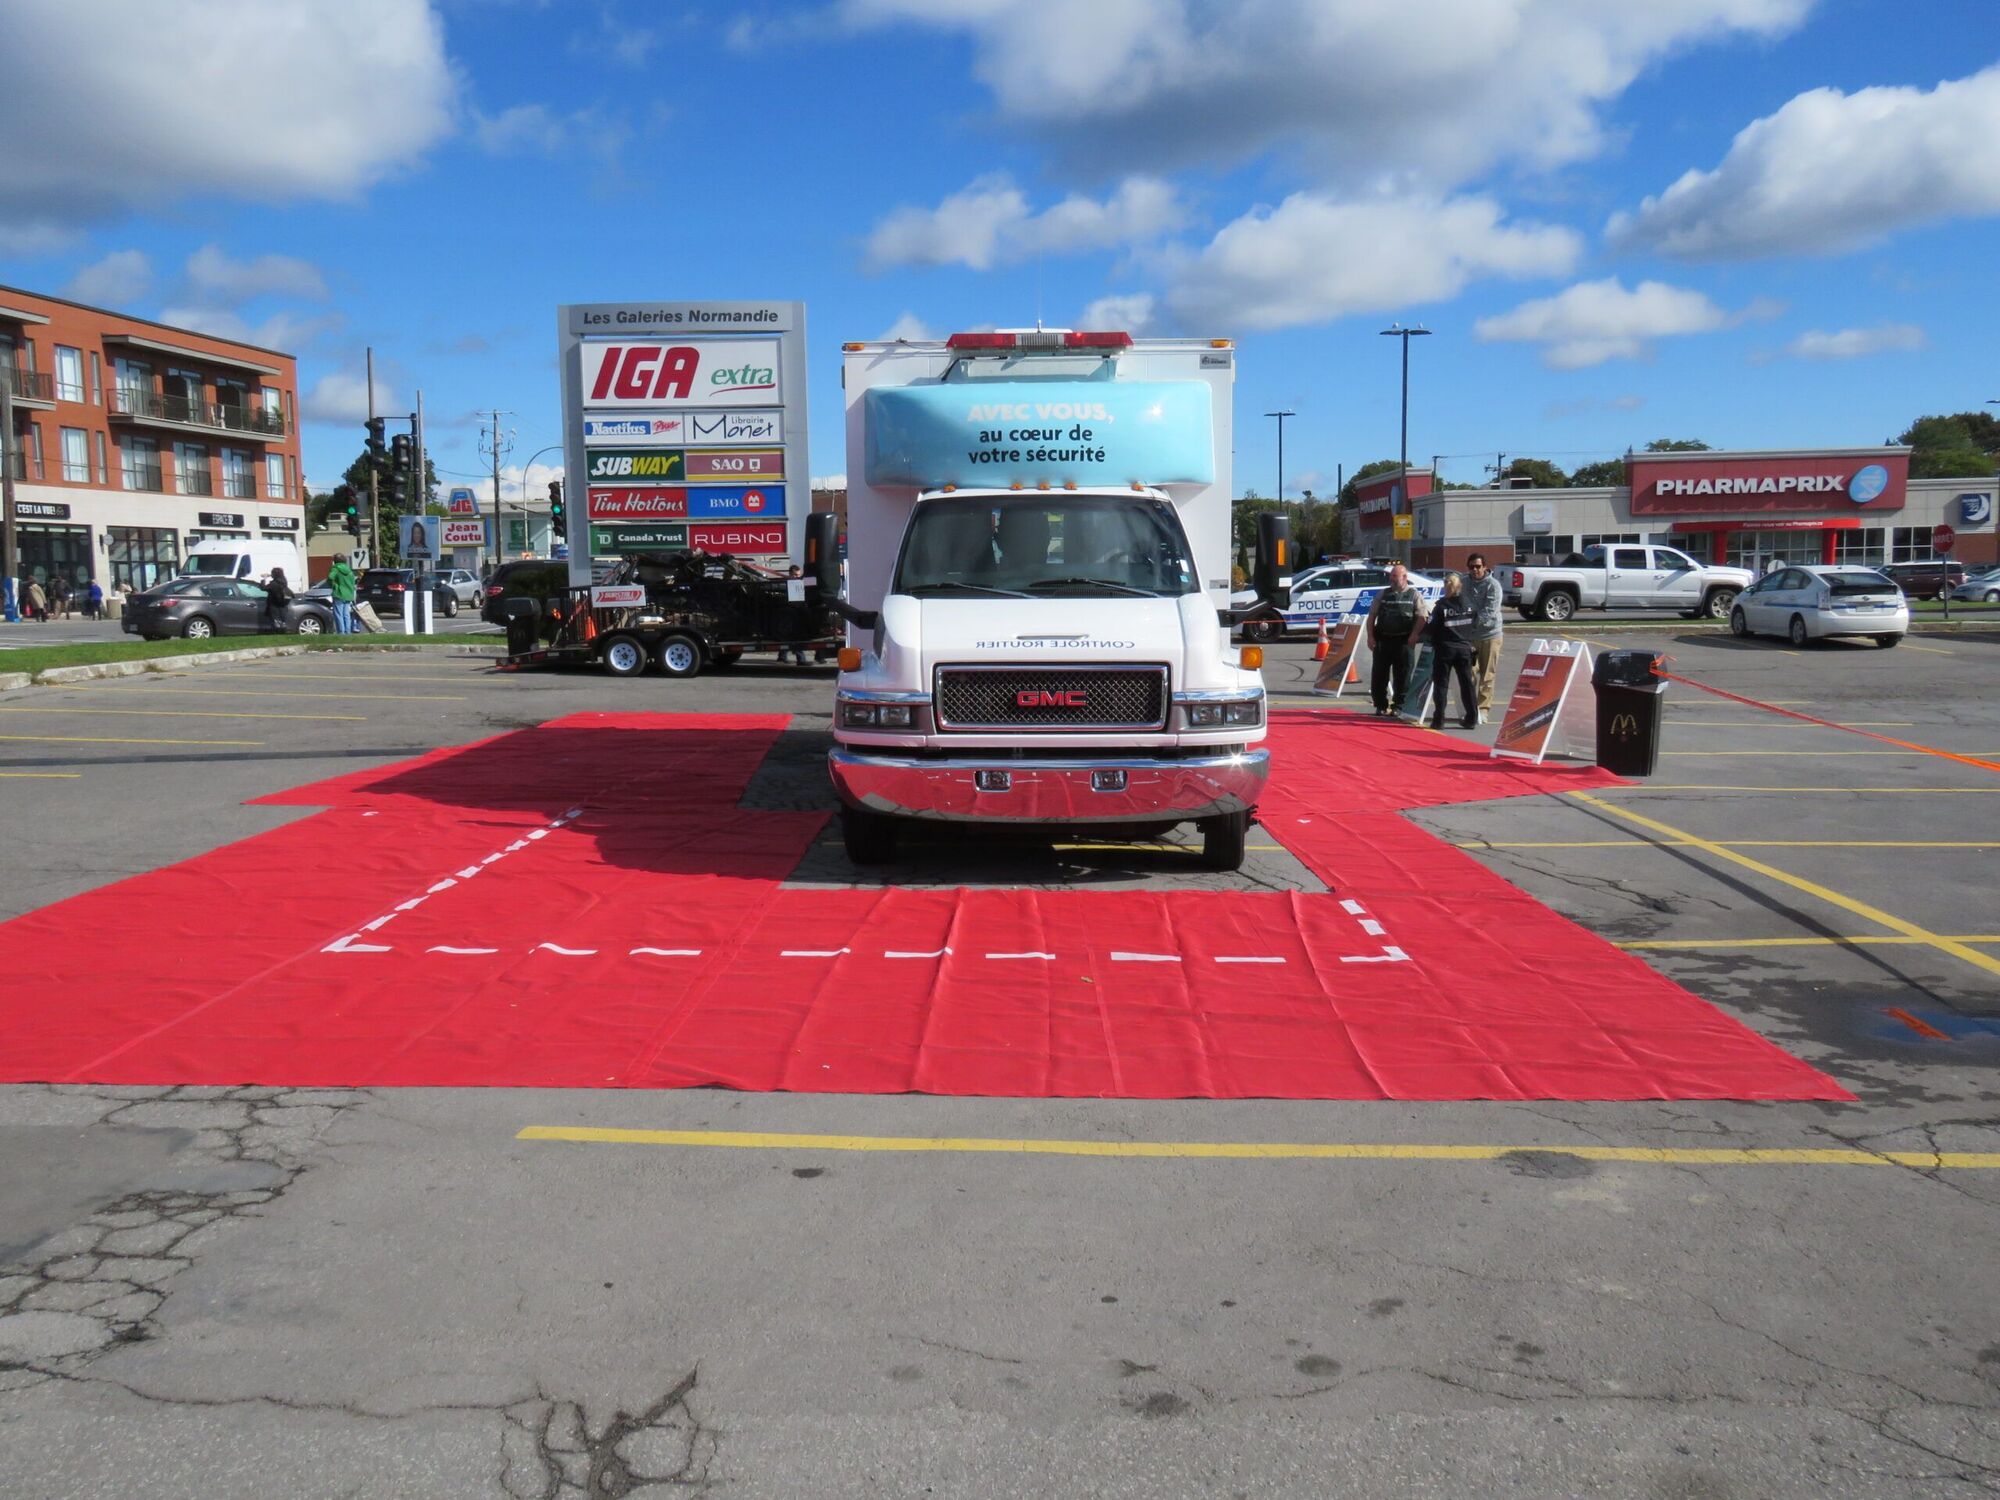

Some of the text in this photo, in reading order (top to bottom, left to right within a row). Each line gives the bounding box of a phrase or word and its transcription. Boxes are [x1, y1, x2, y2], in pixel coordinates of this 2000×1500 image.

[583, 309, 779, 325] Les Galeries Normandie
[590, 346, 773, 399] IGA extra
[731, 416, 764, 424] Librairie
[967, 403, 1115, 425] AVEC VOUS,
[591, 422, 646, 435] Nautilus
[692, 414, 774, 440] Monet
[979, 424, 1093, 443] au cœur de
[968, 445, 1106, 464] votre sécurité
[591, 456, 680, 476] SUBWAY
[711, 458, 744, 471] SAQ
[1656, 475, 1845, 496] PHARMAPRIX
[592, 493, 683, 512] Tim Hortons
[710, 498, 739, 508] BMO
[447, 523, 478, 532] Jean
[445, 533, 482, 542] Coutu
[597, 533, 682, 545] TD Canada Trust
[694, 532, 782, 545] RUBINO
[1298, 600, 1340, 611] POLICE
[1017, 690, 1088, 707] GMC
